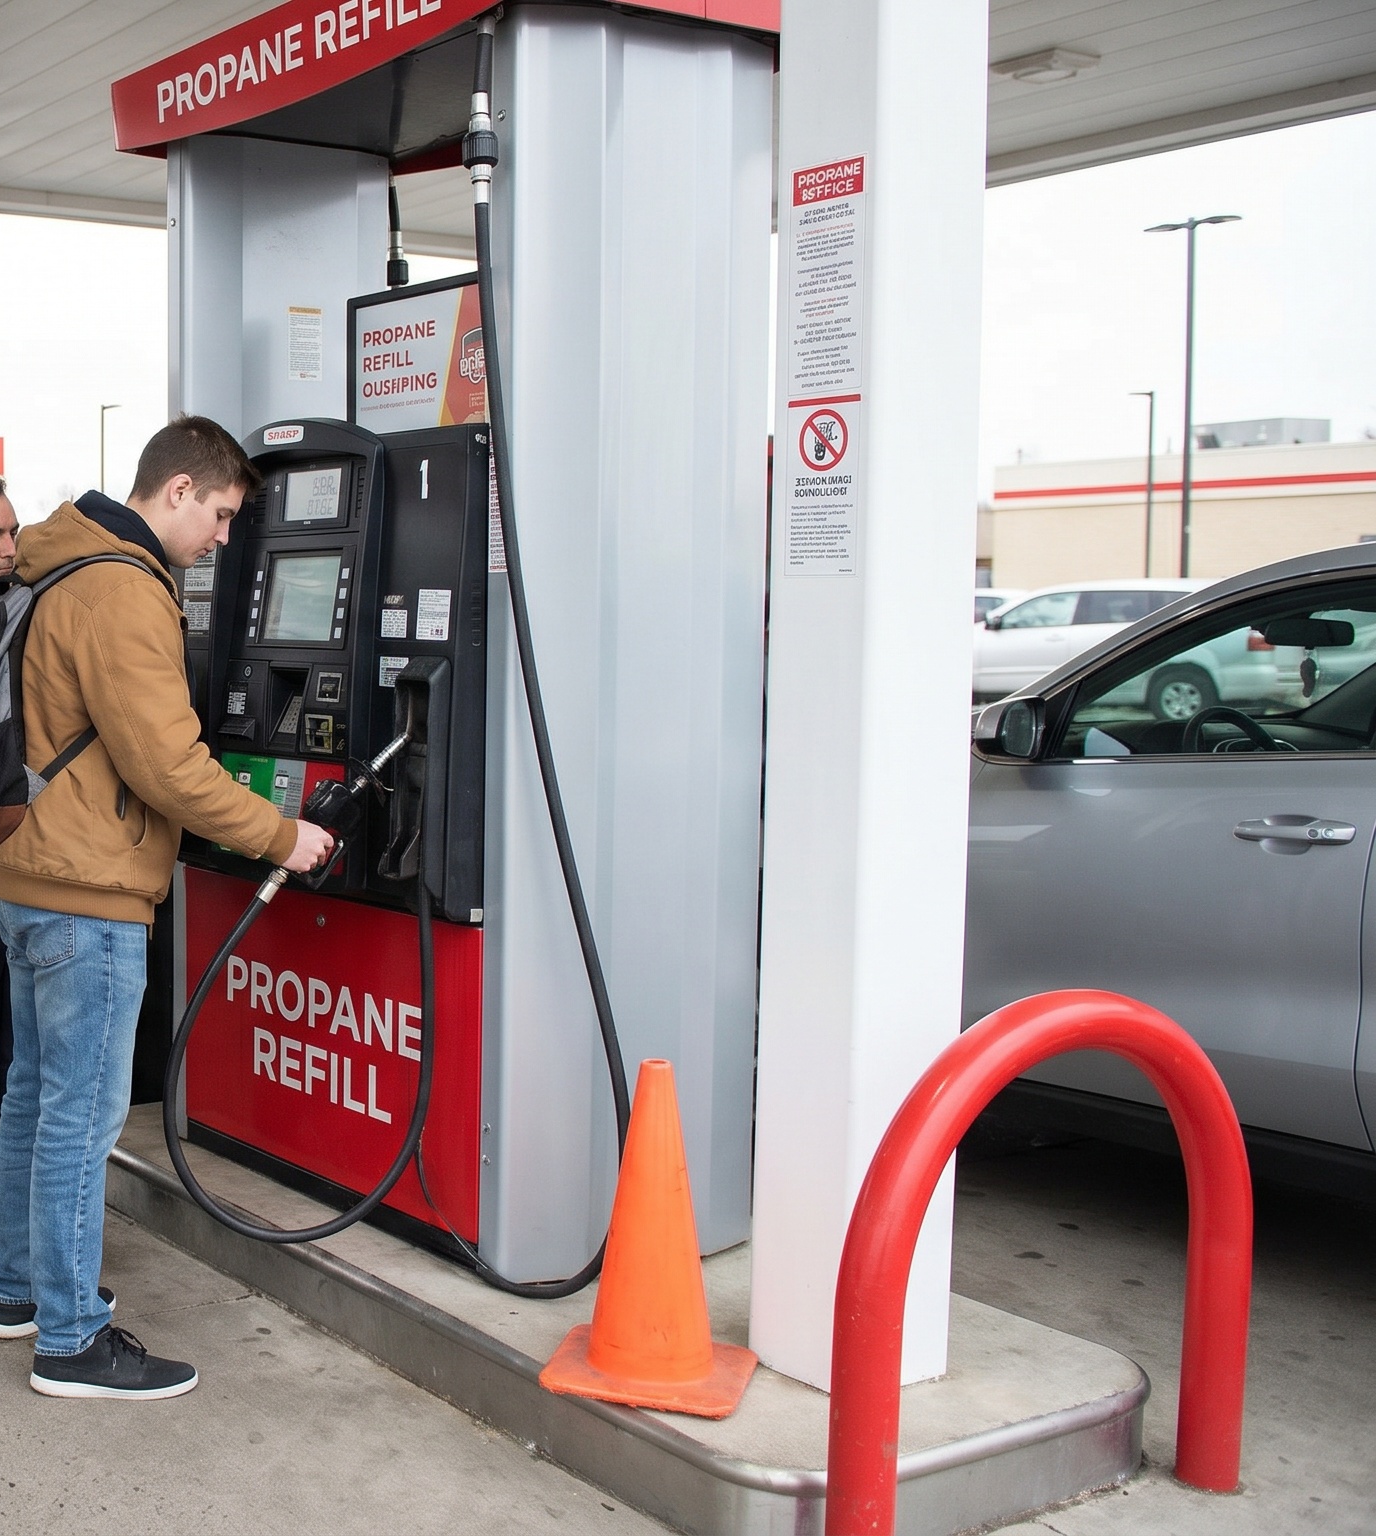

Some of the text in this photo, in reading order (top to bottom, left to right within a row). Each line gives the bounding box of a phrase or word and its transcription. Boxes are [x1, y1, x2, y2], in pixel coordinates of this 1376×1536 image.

[157, 22, 304, 124] PROPANE
[363, 320, 436, 348] PROPANE
[363, 350, 414, 373] REFILL
[418, 458, 430, 500] 1
[227, 954, 423, 1062] PROPANE
[253, 1026, 392, 1125] REFILL
